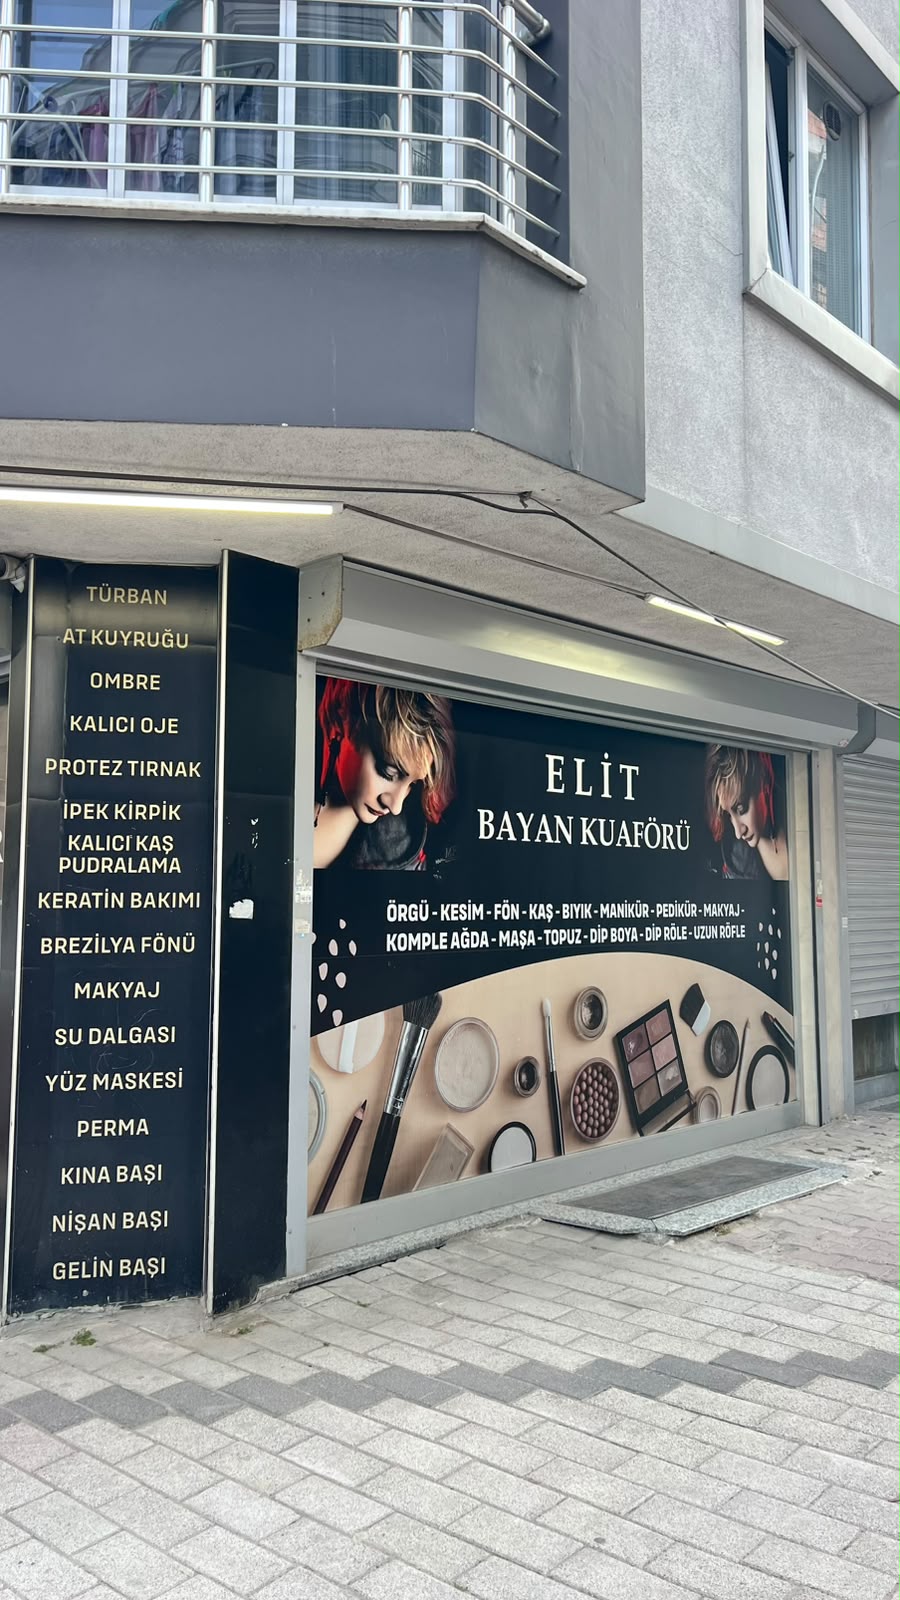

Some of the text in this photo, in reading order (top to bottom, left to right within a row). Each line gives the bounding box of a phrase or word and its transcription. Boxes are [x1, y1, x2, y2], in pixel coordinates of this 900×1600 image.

[86, 584, 168, 605] TÜRBAN
[62, 628, 189, 649] AT KUYRUĞU
[90, 672, 161, 691] OMBRE
[70, 715, 179, 734] KALICI OJE
[45, 757, 201, 778] PROTEZ TIRNAK
[545, 752, 640, 801] ELİT
[63, 799, 182, 821] İPEK KİRPİK
[477, 808, 691, 851] BAYAN KUAFÖRÜ
[68, 834, 174, 855] KALICI KAŞ
[59, 856, 182, 874] PUDRALAMA
[38, 889, 201, 909] KERATİN BAKIMI
[386, 899, 429, 923] ÖRGÜ
[440, 899, 484, 922] KESİM
[494, 899, 520, 921] FÖN
[529, 903, 554, 923] KAŞ
[562, 903, 593, 920] BIYIK
[599, 899, 650, 919] MANİKÜR
[656, 899, 698, 918] PEDİKÜR
[703, 903, 740, 918] MAKYAJ
[40, 932, 195, 955] BREZİLYA FÖNÜ
[386, 931, 448, 952] KOMPLE
[450, 927, 490, 950] AĞDA
[498, 929, 536, 950] MAŞA
[543, 928, 582, 946] TOPUZ
[589, 924, 609, 944] DİP
[610, 926, 639, 943] BOYA
[645, 923, 662, 942] DİP
[693, 925, 718, 940] UZUN
[74, 981, 160, 1000] MAKYAJ
[54, 1026, 176, 1046] SU DALGASI
[45, 1067, 183, 1092] YÜZ MASKESİ
[77, 1118, 149, 1138] PERMA
[61, 1163, 162, 1185] KINA BAŞI
[52, 1210, 168, 1233] NİŞAN BAŞI
[52, 1256, 166, 1281] GELİN BAŞI
